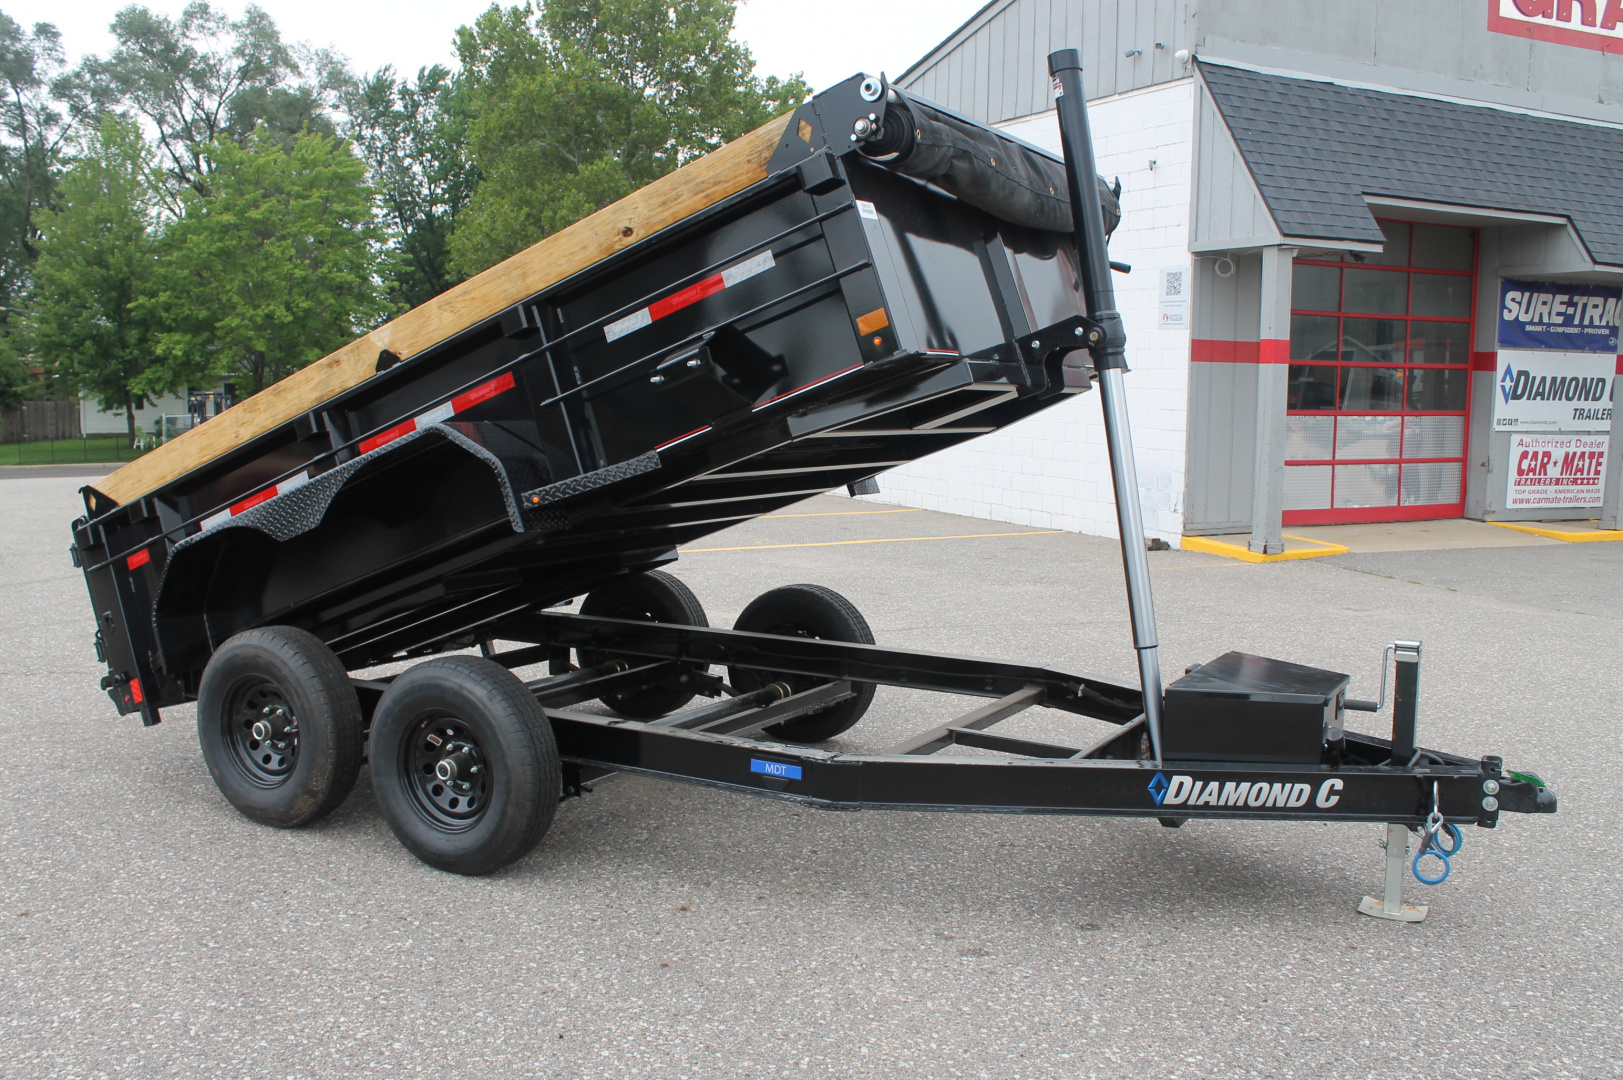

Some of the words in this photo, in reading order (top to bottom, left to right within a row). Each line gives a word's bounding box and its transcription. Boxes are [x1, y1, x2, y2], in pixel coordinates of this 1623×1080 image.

[1550, 326, 1582, 334] CONFIDENT
[1510, 370, 1606, 401] DIAMOND
[1517, 438, 1571, 448] Authorized
[1575, 439, 1605, 448] Dealer
[1517, 450, 1552, 477] CAR
[1560, 451, 1604, 476] MATE
[1515, 478, 1556, 486] TRAILERS
[1559, 478, 1576, 486] INC.
[1512, 495, 1601, 504] www.carmate-trailers.com
[765, 763, 787, 775] MDT
[1163, 775, 1312, 808] DIAMOND
[1316, 778, 1344, 809] C
